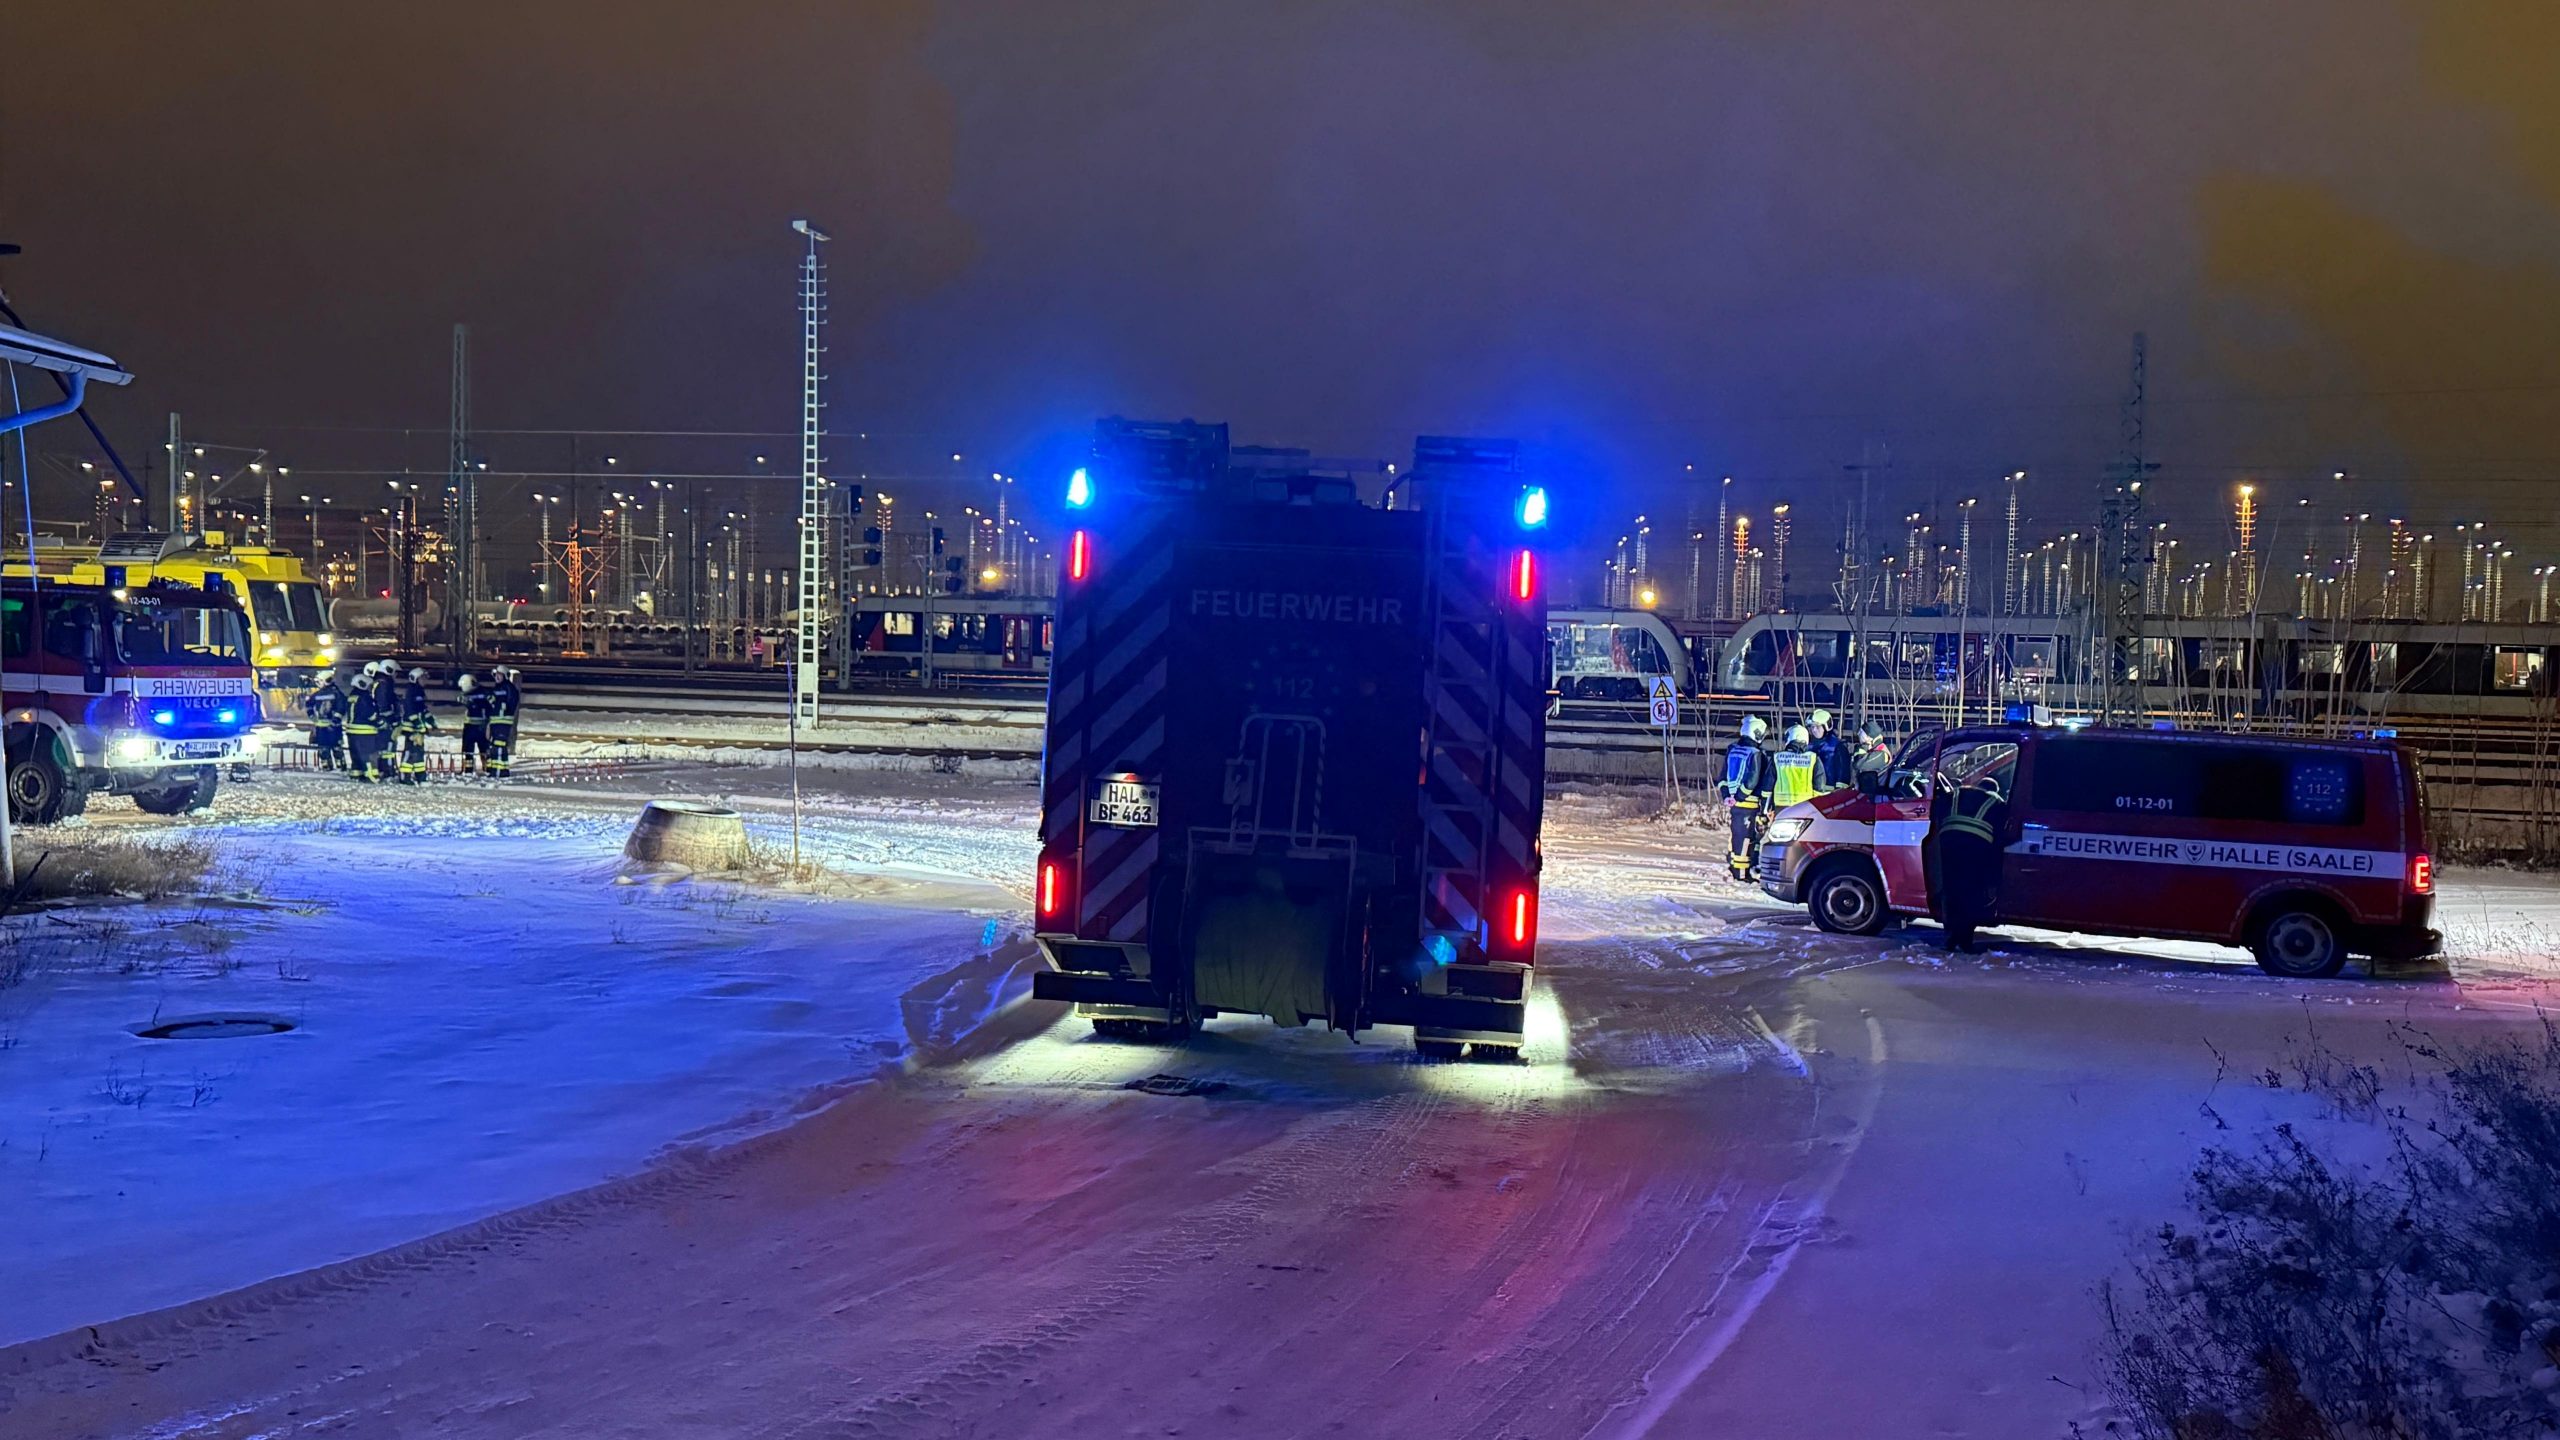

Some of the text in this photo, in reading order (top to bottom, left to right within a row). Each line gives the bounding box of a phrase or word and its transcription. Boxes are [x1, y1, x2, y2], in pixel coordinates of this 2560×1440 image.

[128, 596, 161, 606] 12-43-01
[1190, 589, 1403, 625] FEUERWEHR
[177, 697, 221, 709] IVECO
[1108, 784, 1140, 804] HAL
[2307, 783, 2332, 795] 112
[2115, 795, 2174, 810] 01-12-01
[1098, 803, 1153, 823] BF 463
[2041, 834, 2375, 874] FEUERWEHR HALLE (SAALE)
